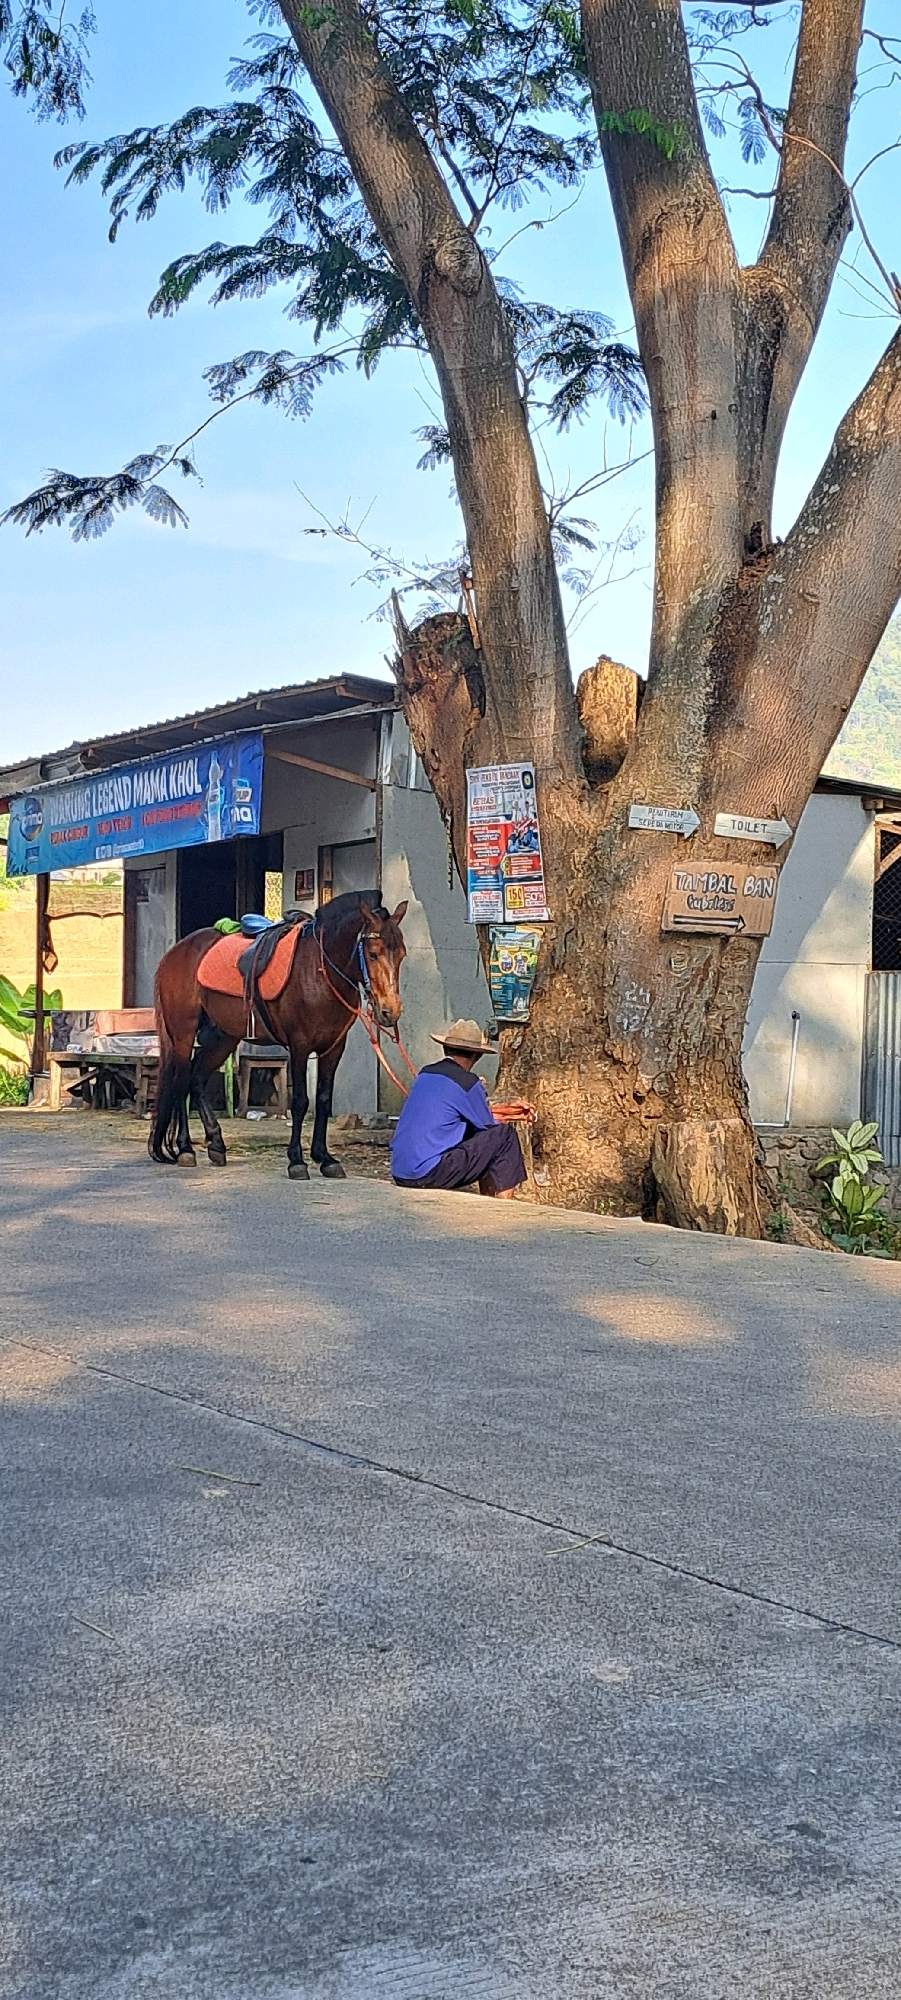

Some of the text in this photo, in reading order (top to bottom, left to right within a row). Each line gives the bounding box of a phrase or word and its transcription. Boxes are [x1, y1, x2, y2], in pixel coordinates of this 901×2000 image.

[50, 757, 203, 826] WARUNG LEGEND MAMA KHOL
[730, 819, 768, 834] TOILET
[508, 887, 523, 901] 150
[674, 871, 775, 898] TAMBAL BAN
